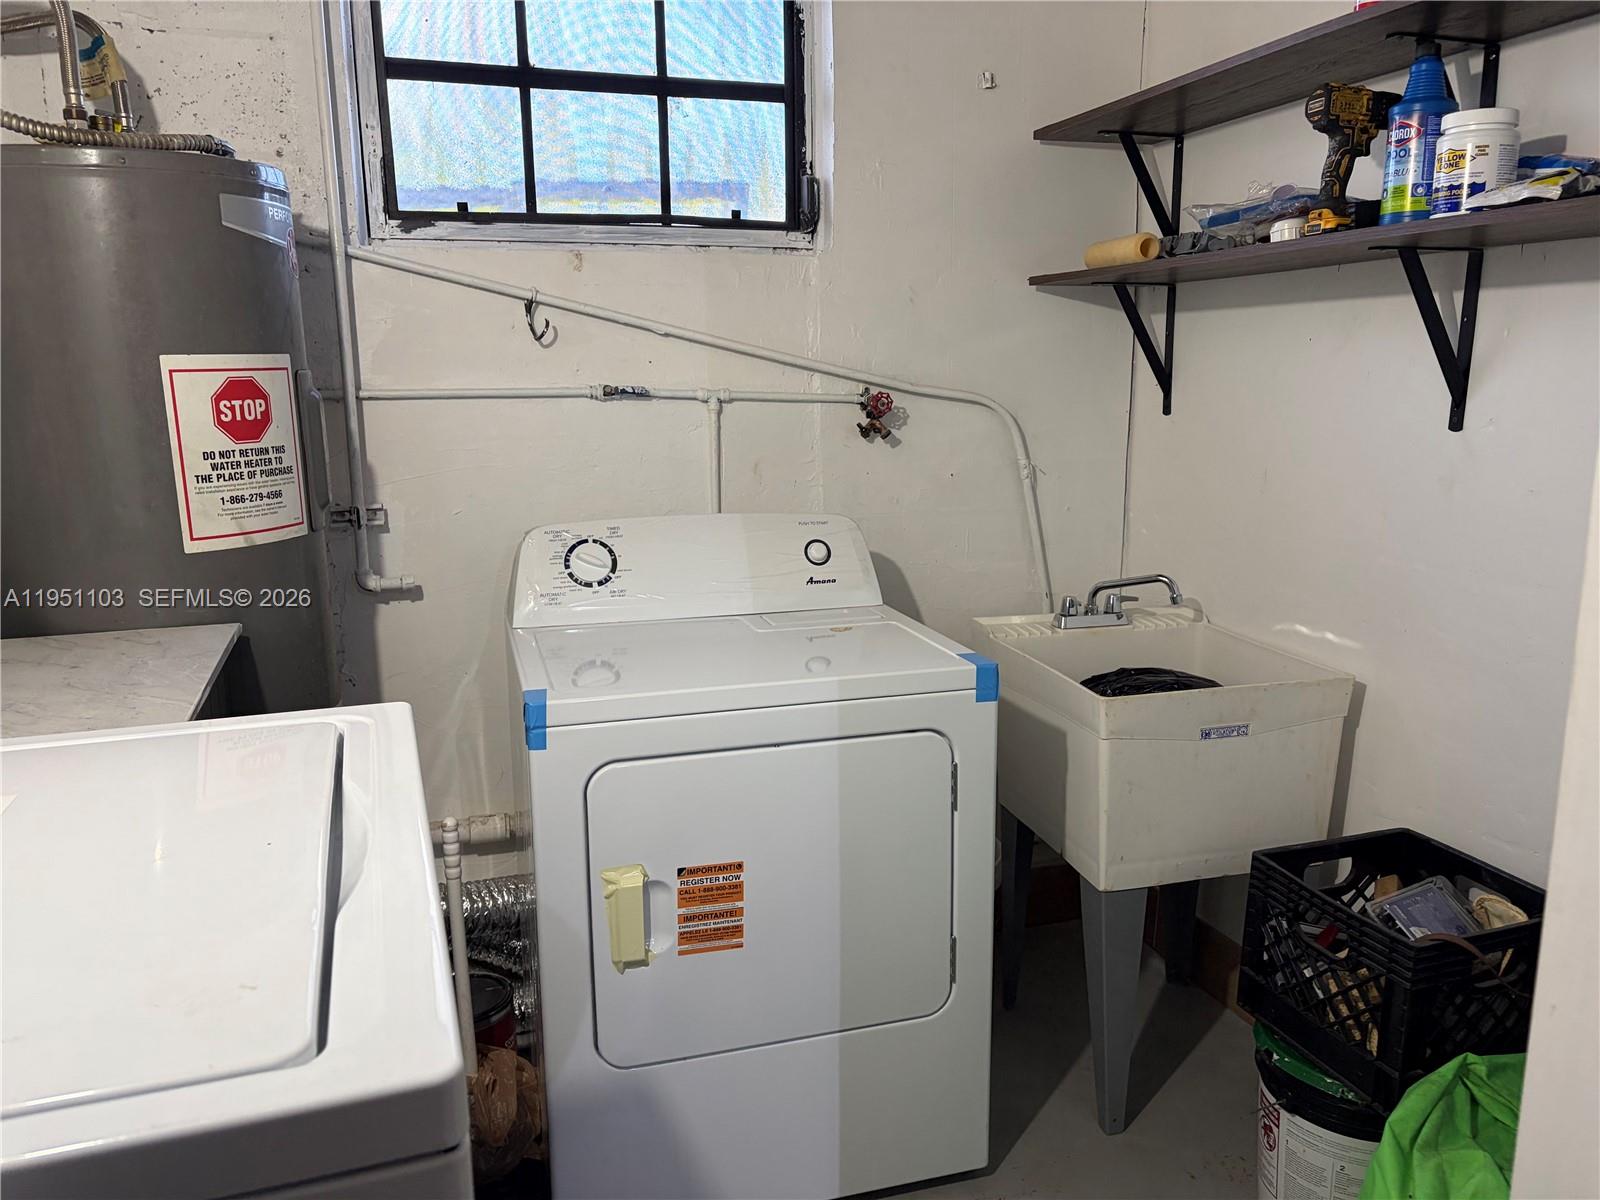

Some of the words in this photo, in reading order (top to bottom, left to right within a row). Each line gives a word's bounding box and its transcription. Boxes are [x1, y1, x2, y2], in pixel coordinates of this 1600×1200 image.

[219, 400, 265, 422] STOP
[203, 451, 216, 460] DO
[219, 450, 236, 459] NOT
[240, 448, 270, 458] RETURN
[271, 445, 286, 454] THIS
[210, 461, 242, 471] WATER
[244, 458, 273, 468] HEATER
[275, 457, 283, 465] TO
[194, 474, 213, 484] THE
[217, 472, 245, 482] PLACE
[247, 471, 257, 479] OF
[260, 466, 294, 478] PURCHASE
[220, 490, 283, 505] 1-866-279-4566
[806, 576, 836, 585] Amana
[687, 864, 736, 875] IMPORTANT!
[680, 876, 720, 886] REGISTER
[722, 874, 741, 883] NOW
[683, 910, 737, 922] IMPORTANTE!
